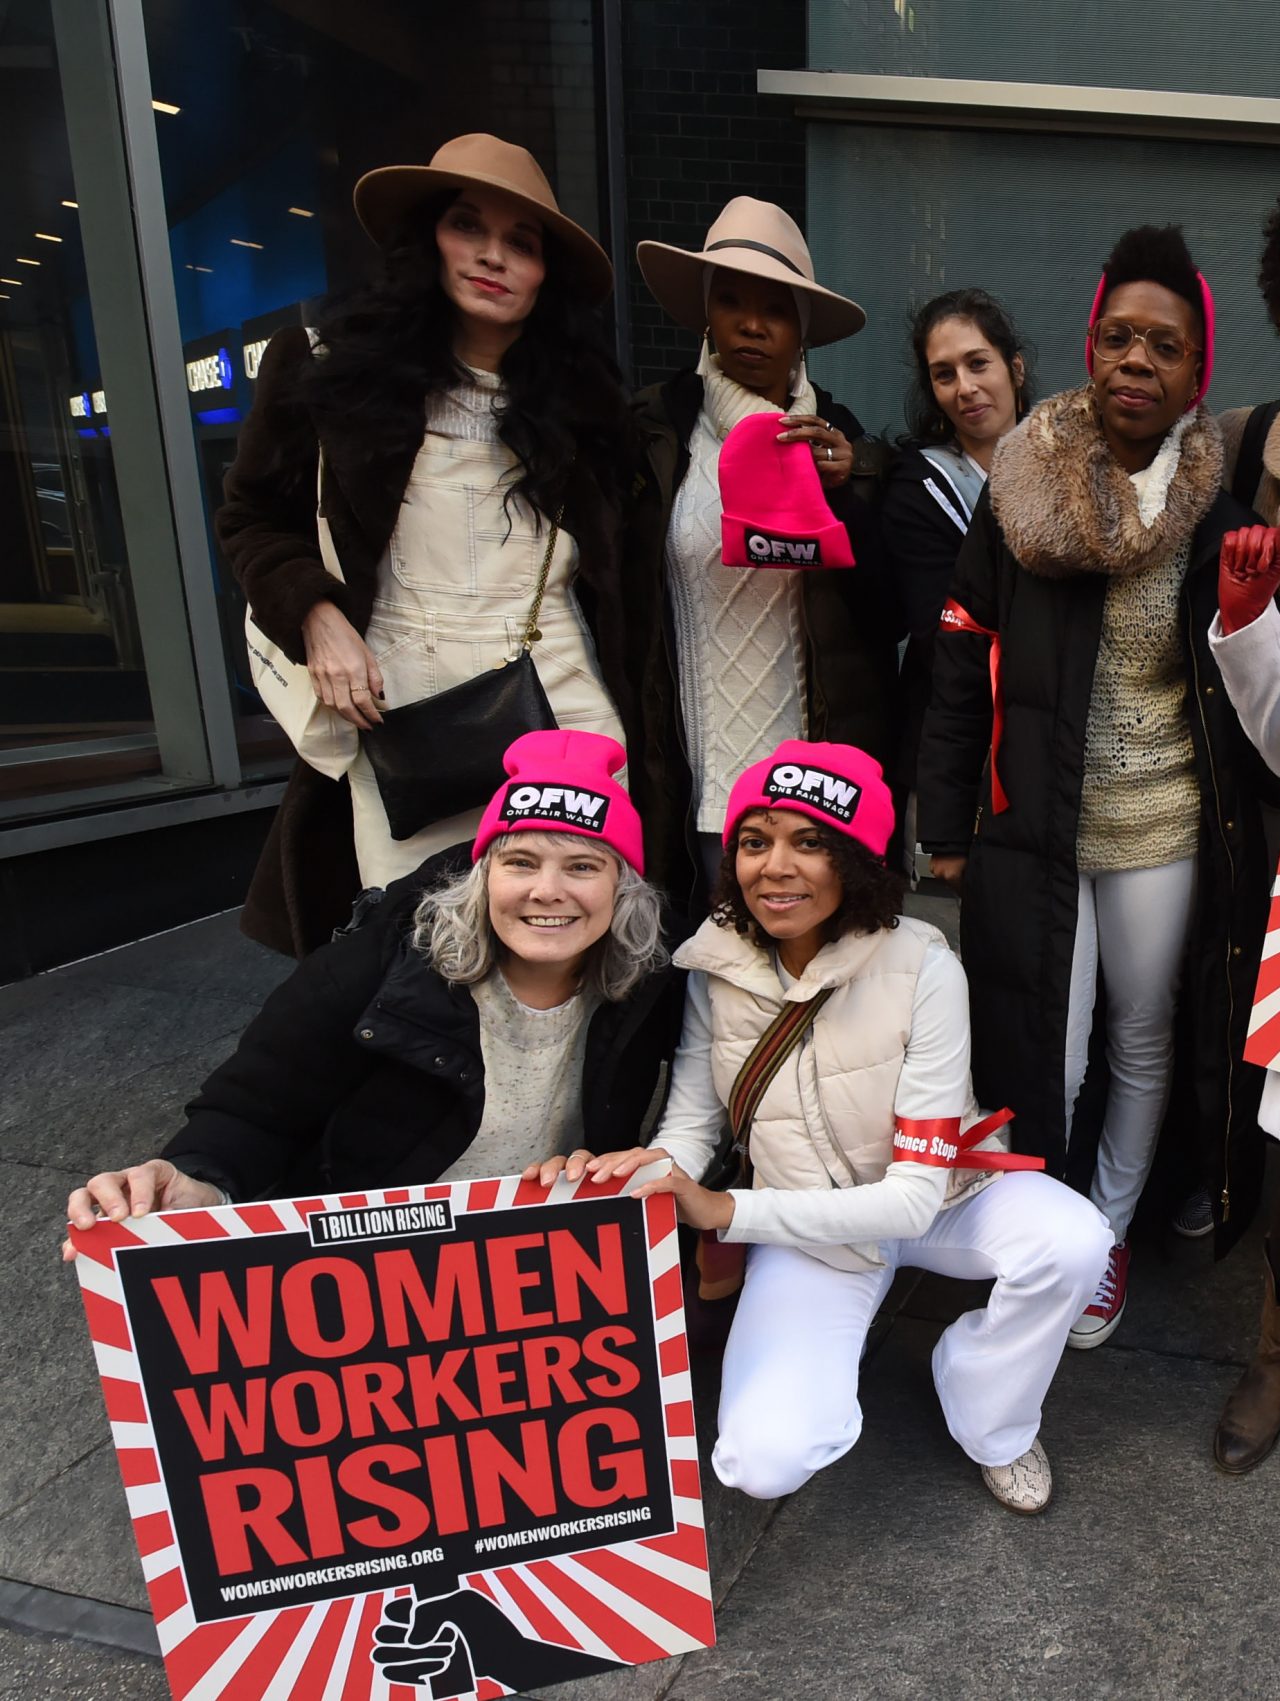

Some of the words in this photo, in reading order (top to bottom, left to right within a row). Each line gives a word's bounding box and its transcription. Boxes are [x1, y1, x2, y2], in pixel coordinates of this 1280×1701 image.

[186, 354, 223, 392] CHASE
[748, 534, 816, 560] OFW
[509, 786, 605, 818] OFW
[769, 785, 793, 794] ONE
[795, 790, 820, 803] FAIR
[822, 798, 851, 818] WAGE
[772, 765, 858, 807] OFW
[506, 808, 530, 816] ONE
[534, 808, 562, 817] FAIR
[565, 813, 600, 828] WAGE
[929, 1136, 958, 1162] Stops
[395, 1204, 447, 1232] RISING
[150, 1223, 629, 1375] WOMEN
[172, 1325, 641, 1462] WORKERS
[199, 1407, 648, 1577] RISING
[220, 1547, 444, 1602] WOMENWORKERSRISING.ORG
[474, 1506, 652, 1555] #WOMENWORKERSRISING
